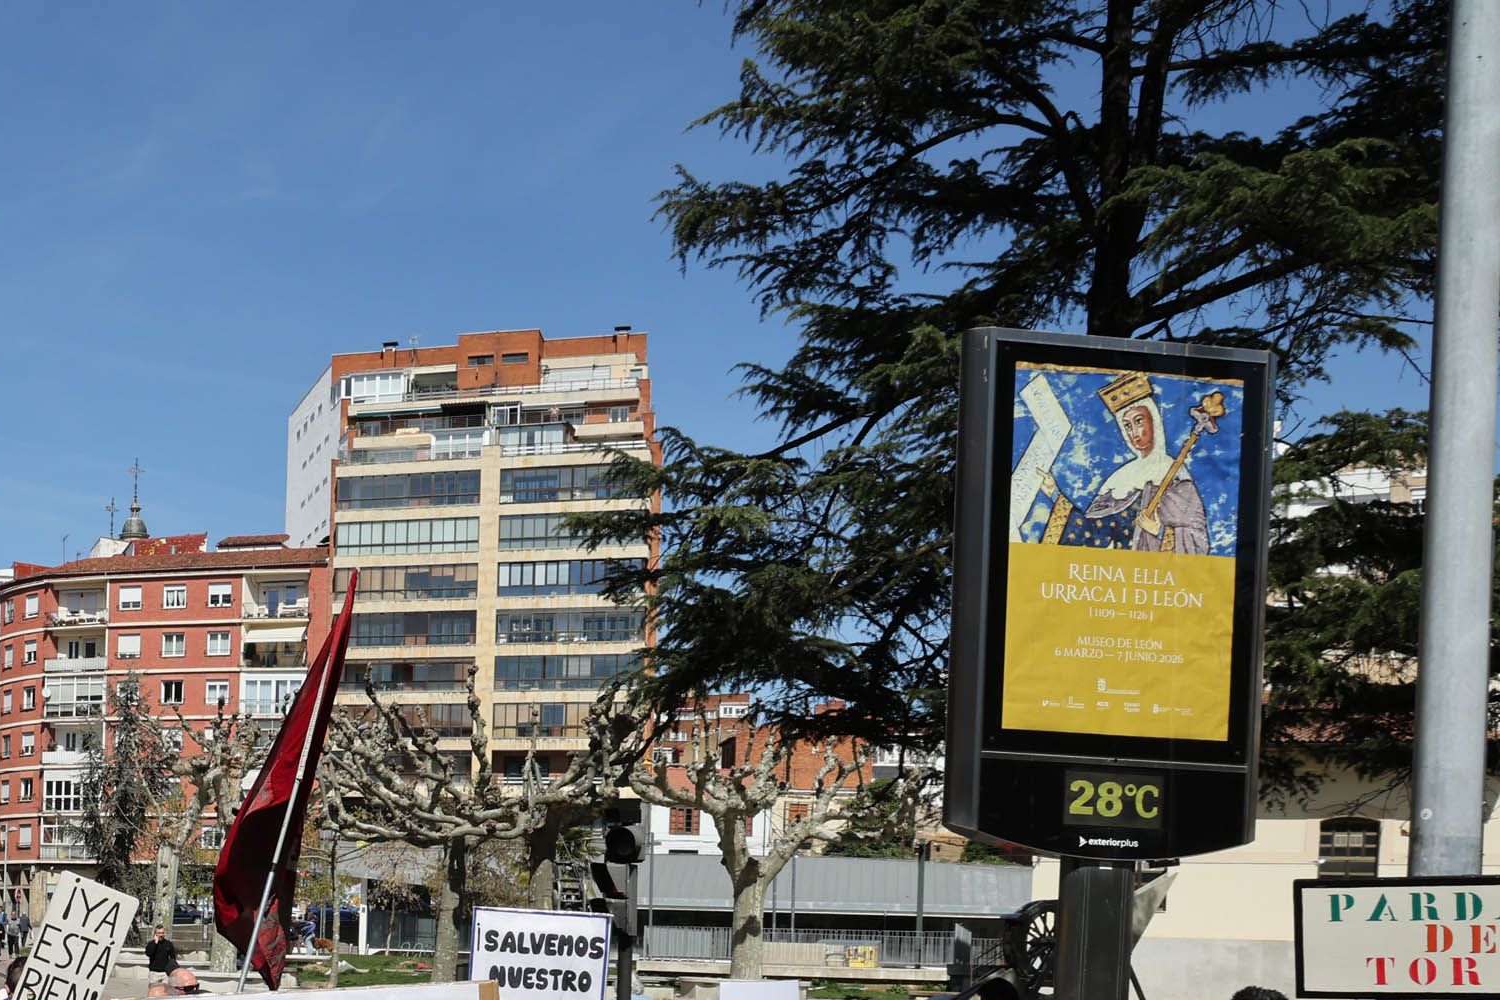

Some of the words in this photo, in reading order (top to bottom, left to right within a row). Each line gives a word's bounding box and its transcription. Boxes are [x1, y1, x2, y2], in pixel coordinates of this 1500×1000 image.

[1069, 563, 1125, 583] REINA
[1133, 567, 1176, 586] ELLA
[1041, 582, 1116, 604] URRACA
[1153, 588, 1203, 608] LEÓN
[1054, 647, 1061, 657] 6
[1063, 647, 1104, 659] MARZO
[1124, 650, 1157, 663] JUNIO
[1159, 654, 1184, 664] 2026
[1077, 635, 1115, 648] MUSEO
[1117, 637, 1132, 649] DE
[1068, 779, 1160, 819] 28°C
[1087, 836, 1139, 848] exteriorplus
[62, 877, 121, 939] ¡YA
[1328, 892, 1500, 922] PARD
[1425, 924, 1497, 953] DE
[33, 922, 116, 985] ESTÁ
[489, 965, 592, 993] NUESTRO
